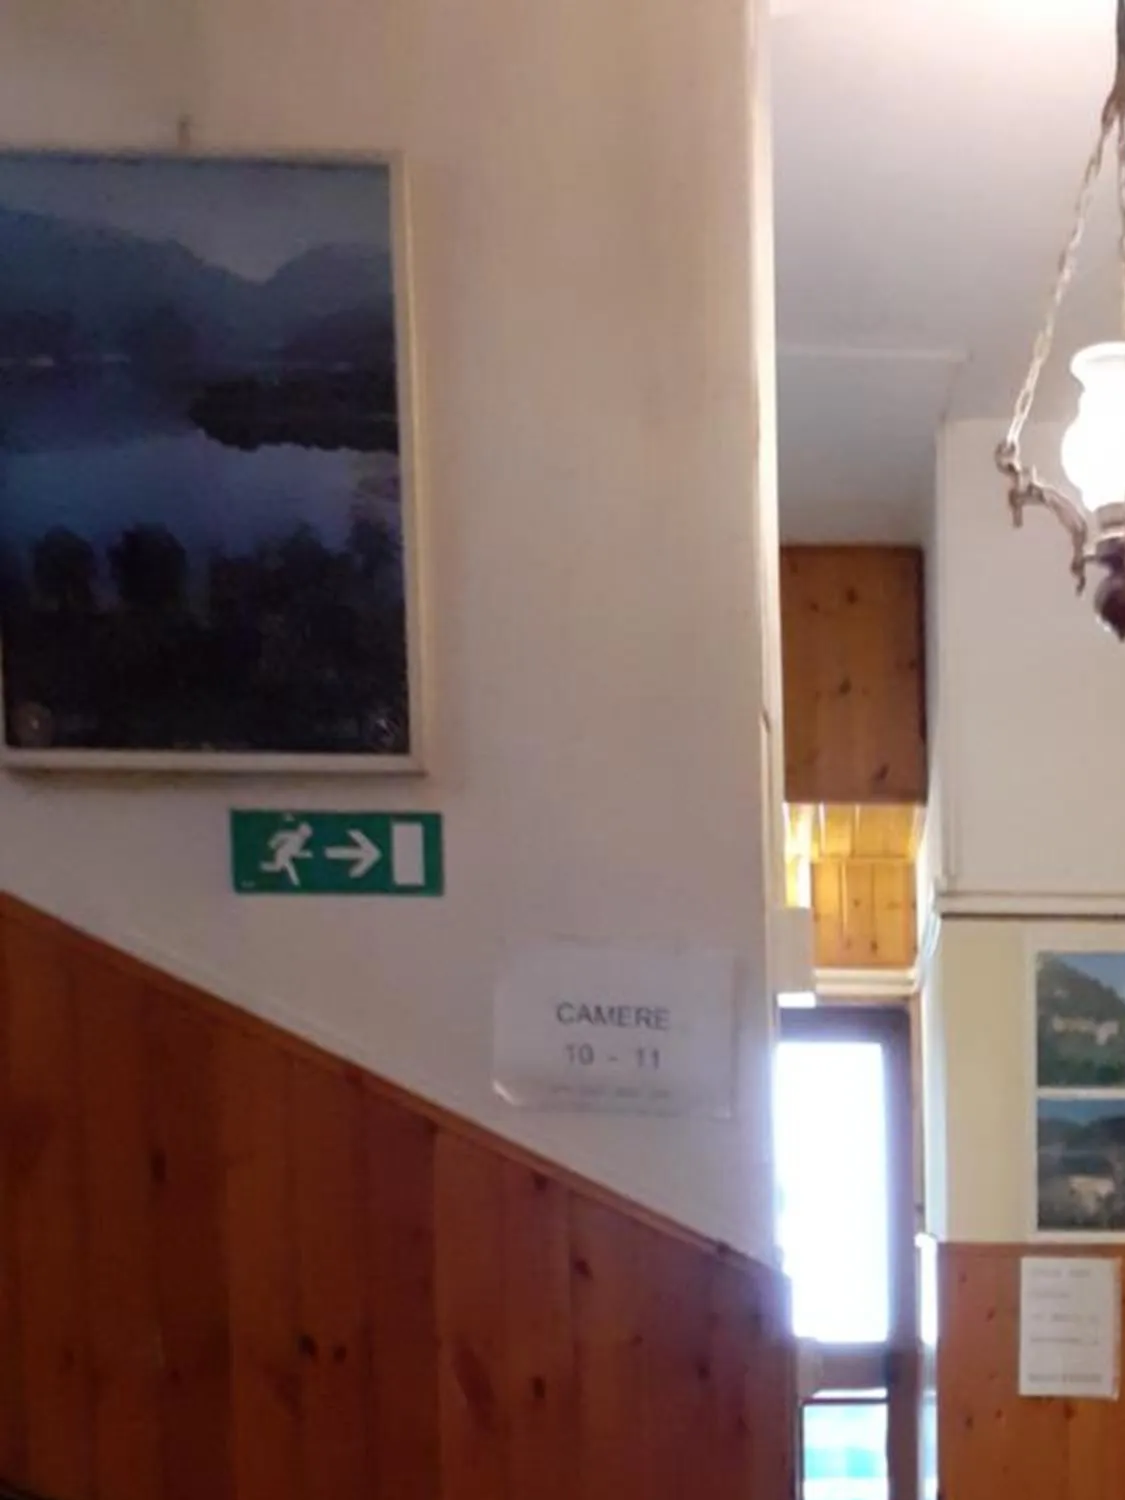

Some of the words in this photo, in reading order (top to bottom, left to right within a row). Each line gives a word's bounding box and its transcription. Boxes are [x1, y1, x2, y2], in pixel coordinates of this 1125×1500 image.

[556, 1002, 670, 1030] CAMERE
[566, 1043, 594, 1066] 10
[637, 1047, 661, 1070] 11
